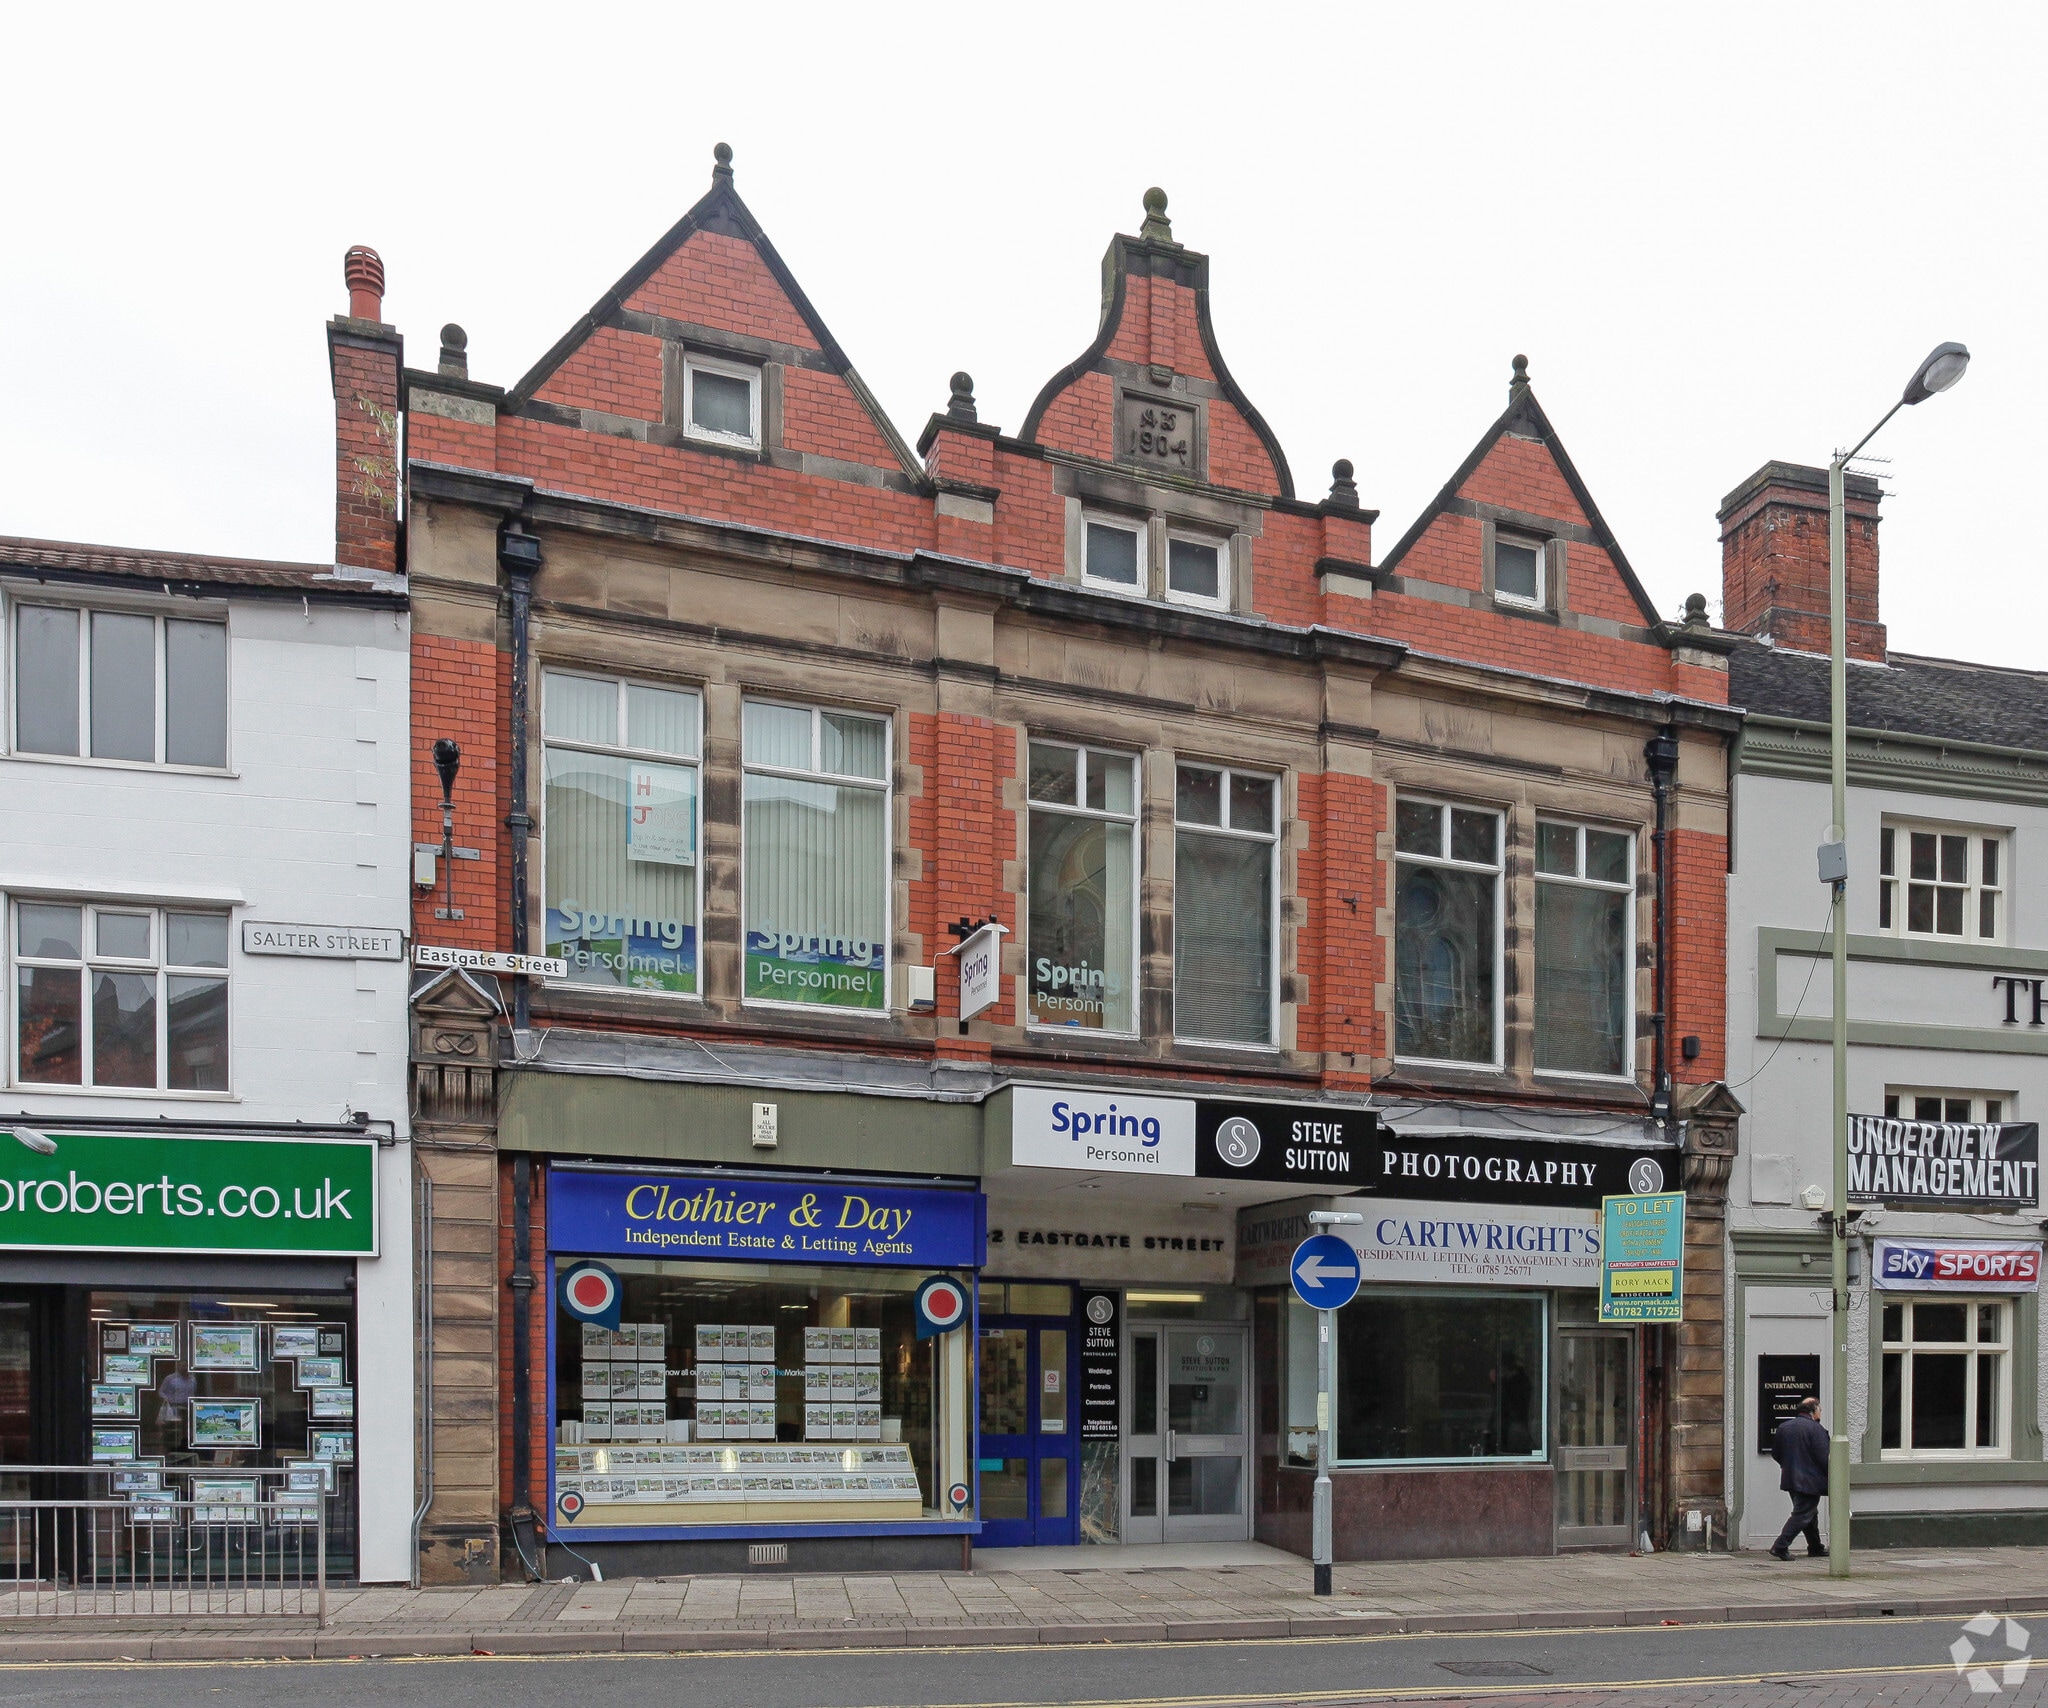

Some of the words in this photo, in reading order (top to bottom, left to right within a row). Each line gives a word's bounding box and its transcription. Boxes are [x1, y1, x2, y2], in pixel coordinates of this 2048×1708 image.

[633, 806, 689, 830] JOBS
[559, 899, 684, 949] Spring
[253, 931, 320, 949] SALTER
[327, 935, 392, 951] STREET
[757, 918, 873, 967] Spring
[420, 947, 497, 970] Eastgate
[506, 956, 560, 973] Street
[561, 942, 683, 976] Personnel
[964, 953, 987, 987] Spring
[758, 961, 872, 993] Personnel
[970, 980, 988, 996] Personnel
[1036, 957, 1122, 995] Spring
[1036, 990, 1116, 1014] Personne
[1051, 1102, 1161, 1148] Spring
[1292, 1121, 1343, 1145] STEVE
[1848, 1116, 1937, 1157] UNDER
[1941, 1124, 2001, 1159] NEW
[1086, 1146, 1160, 1164] Personnel
[1285, 1148, 1350, 1172] SUTTON
[1383, 1150, 1597, 1186] PHOTOGRAPHY
[1848, 1154, 2037, 1197] MANAGEMENT
[626, 1184, 776, 1225] Clothier
[789, 1193, 822, 1227] &
[837, 1195, 912, 1240] Day
[1614, 1202, 1637, 1215] TO
[1643, 1200, 1675, 1214] LET
[625, 1228, 722, 1247] Independent
[727, 1232, 775, 1248] Estate
[781, 1234, 796, 1249] &
[801, 1236, 858, 1255] Letting
[863, 1238, 913, 1255] Agents
[1019, 1231, 1130, 1248] EASTGATE
[1144, 1237, 1224, 1252] STREET
[1376, 1219, 1600, 1254] CARTWRIGHT'S
[1356, 1249, 1428, 1262] RESIDENTIAL
[1433, 1252, 1479, 1264] LETTING
[1483, 1254, 1490, 1263] &
[1495, 1254, 1570, 1267] MANAGEMENT
[1450, 1264, 1473, 1274] TEL:
[1476, 1265, 1500, 1275] 01785
[1504, 1266, 1531, 1276] 256771
[1888, 1250, 1929, 1278] sky
[1939, 1254, 2034, 1276] SPORTS
[1613, 1298, 1679, 1307] www.rorymack.co.uk
[1613, 1307, 1641, 1316] 01782
[1646, 1307, 1680, 1316] 715725
[1086, 1339, 1115, 1347] SUTTON
[1089, 1328, 1111, 1336] STEVE
[1182, 1356, 1200, 1364] STEVE
[1205, 1356, 1230, 1365] SUTTON
